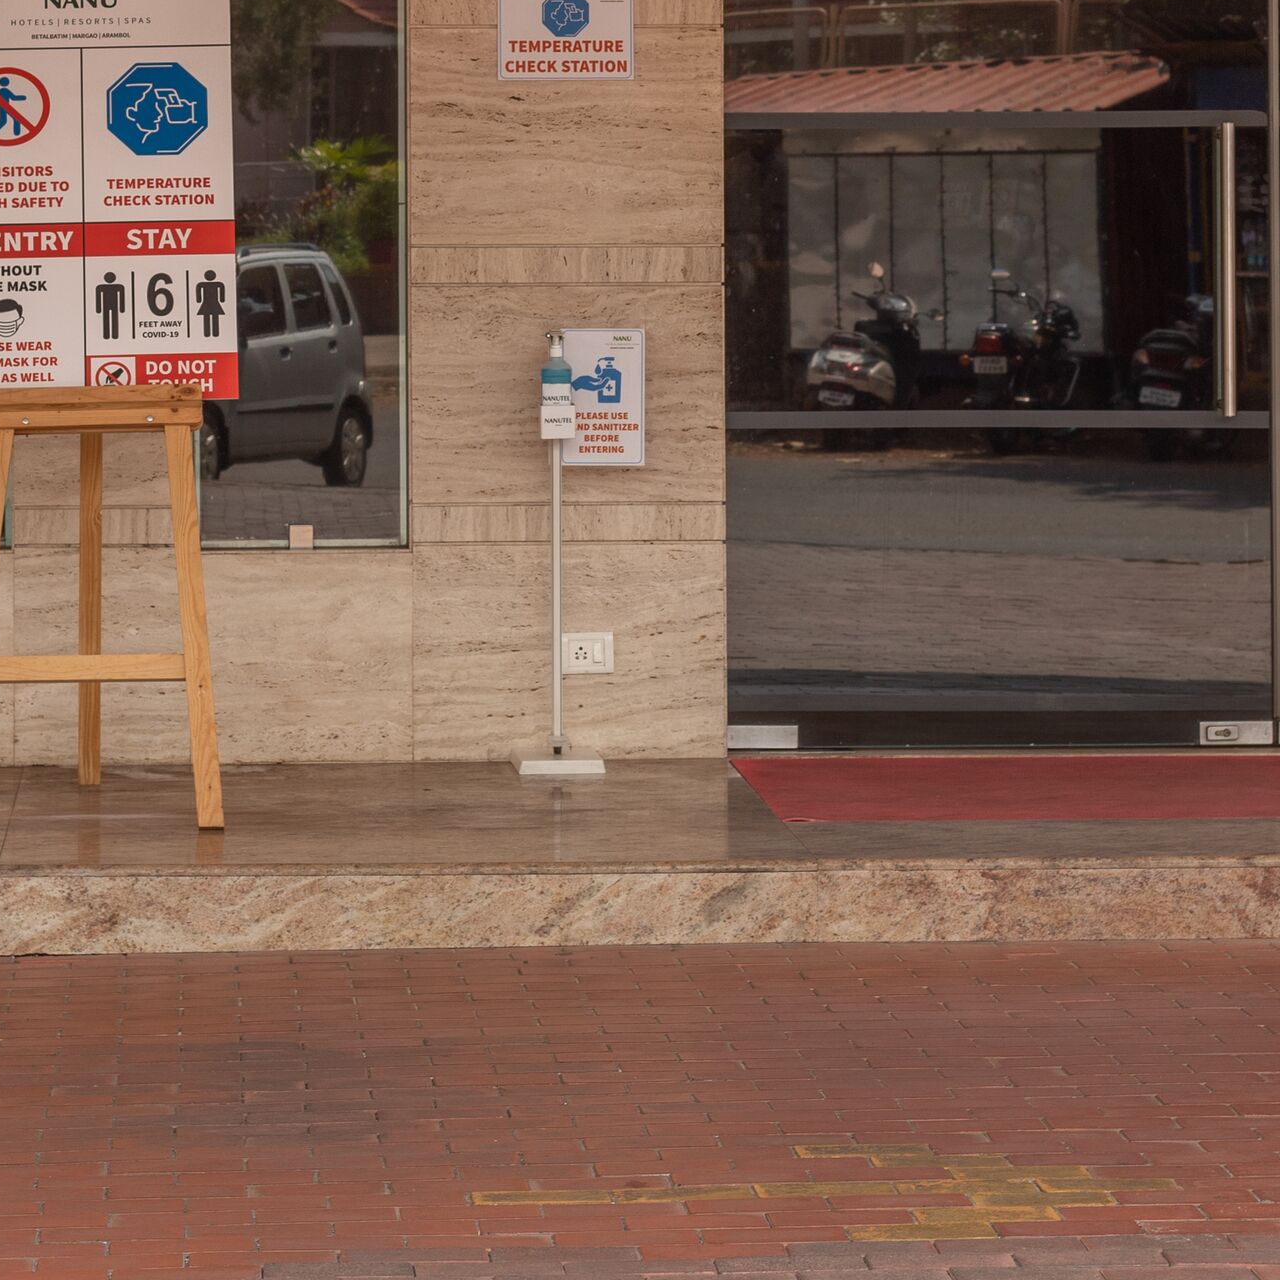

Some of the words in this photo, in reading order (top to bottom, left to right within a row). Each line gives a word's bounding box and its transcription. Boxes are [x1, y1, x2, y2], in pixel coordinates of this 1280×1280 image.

[10, 18, 55, 26] HOTELS
[63, 17, 114, 26] RESORTS
[124, 16, 151, 25] SPAS
[31, 32, 69, 40] BETALBATIM
[102, 31, 130, 39] ARAMBOL
[509, 40, 623, 53] TEMPERATURE
[505, 60, 557, 73] CHECK
[562, 60, 627, 73] STATION
[18, 180, 46, 193] DUE
[49, 180, 70, 192] TO
[106, 177, 211, 190] TEMPERATURE
[12, 196, 64, 209] SAFETY
[103, 194, 151, 206] CHECK
[154, 193, 215, 206] STATION
[126, 228, 192, 250] STAY
[7, 280, 47, 292] MASK
[146, 273, 175, 316] 6
[138, 320, 157, 328] FEET
[159, 320, 182, 328] AWAY
[142, 330, 179, 338] COVID-19
[16, 341, 52, 351] WEAR
[33, 356, 58, 367] FOR
[145, 360, 171, 375] DO
[176, 359, 217, 374] NOT
[1, 373, 18, 383] AS
[21, 372, 54, 383] WELL
